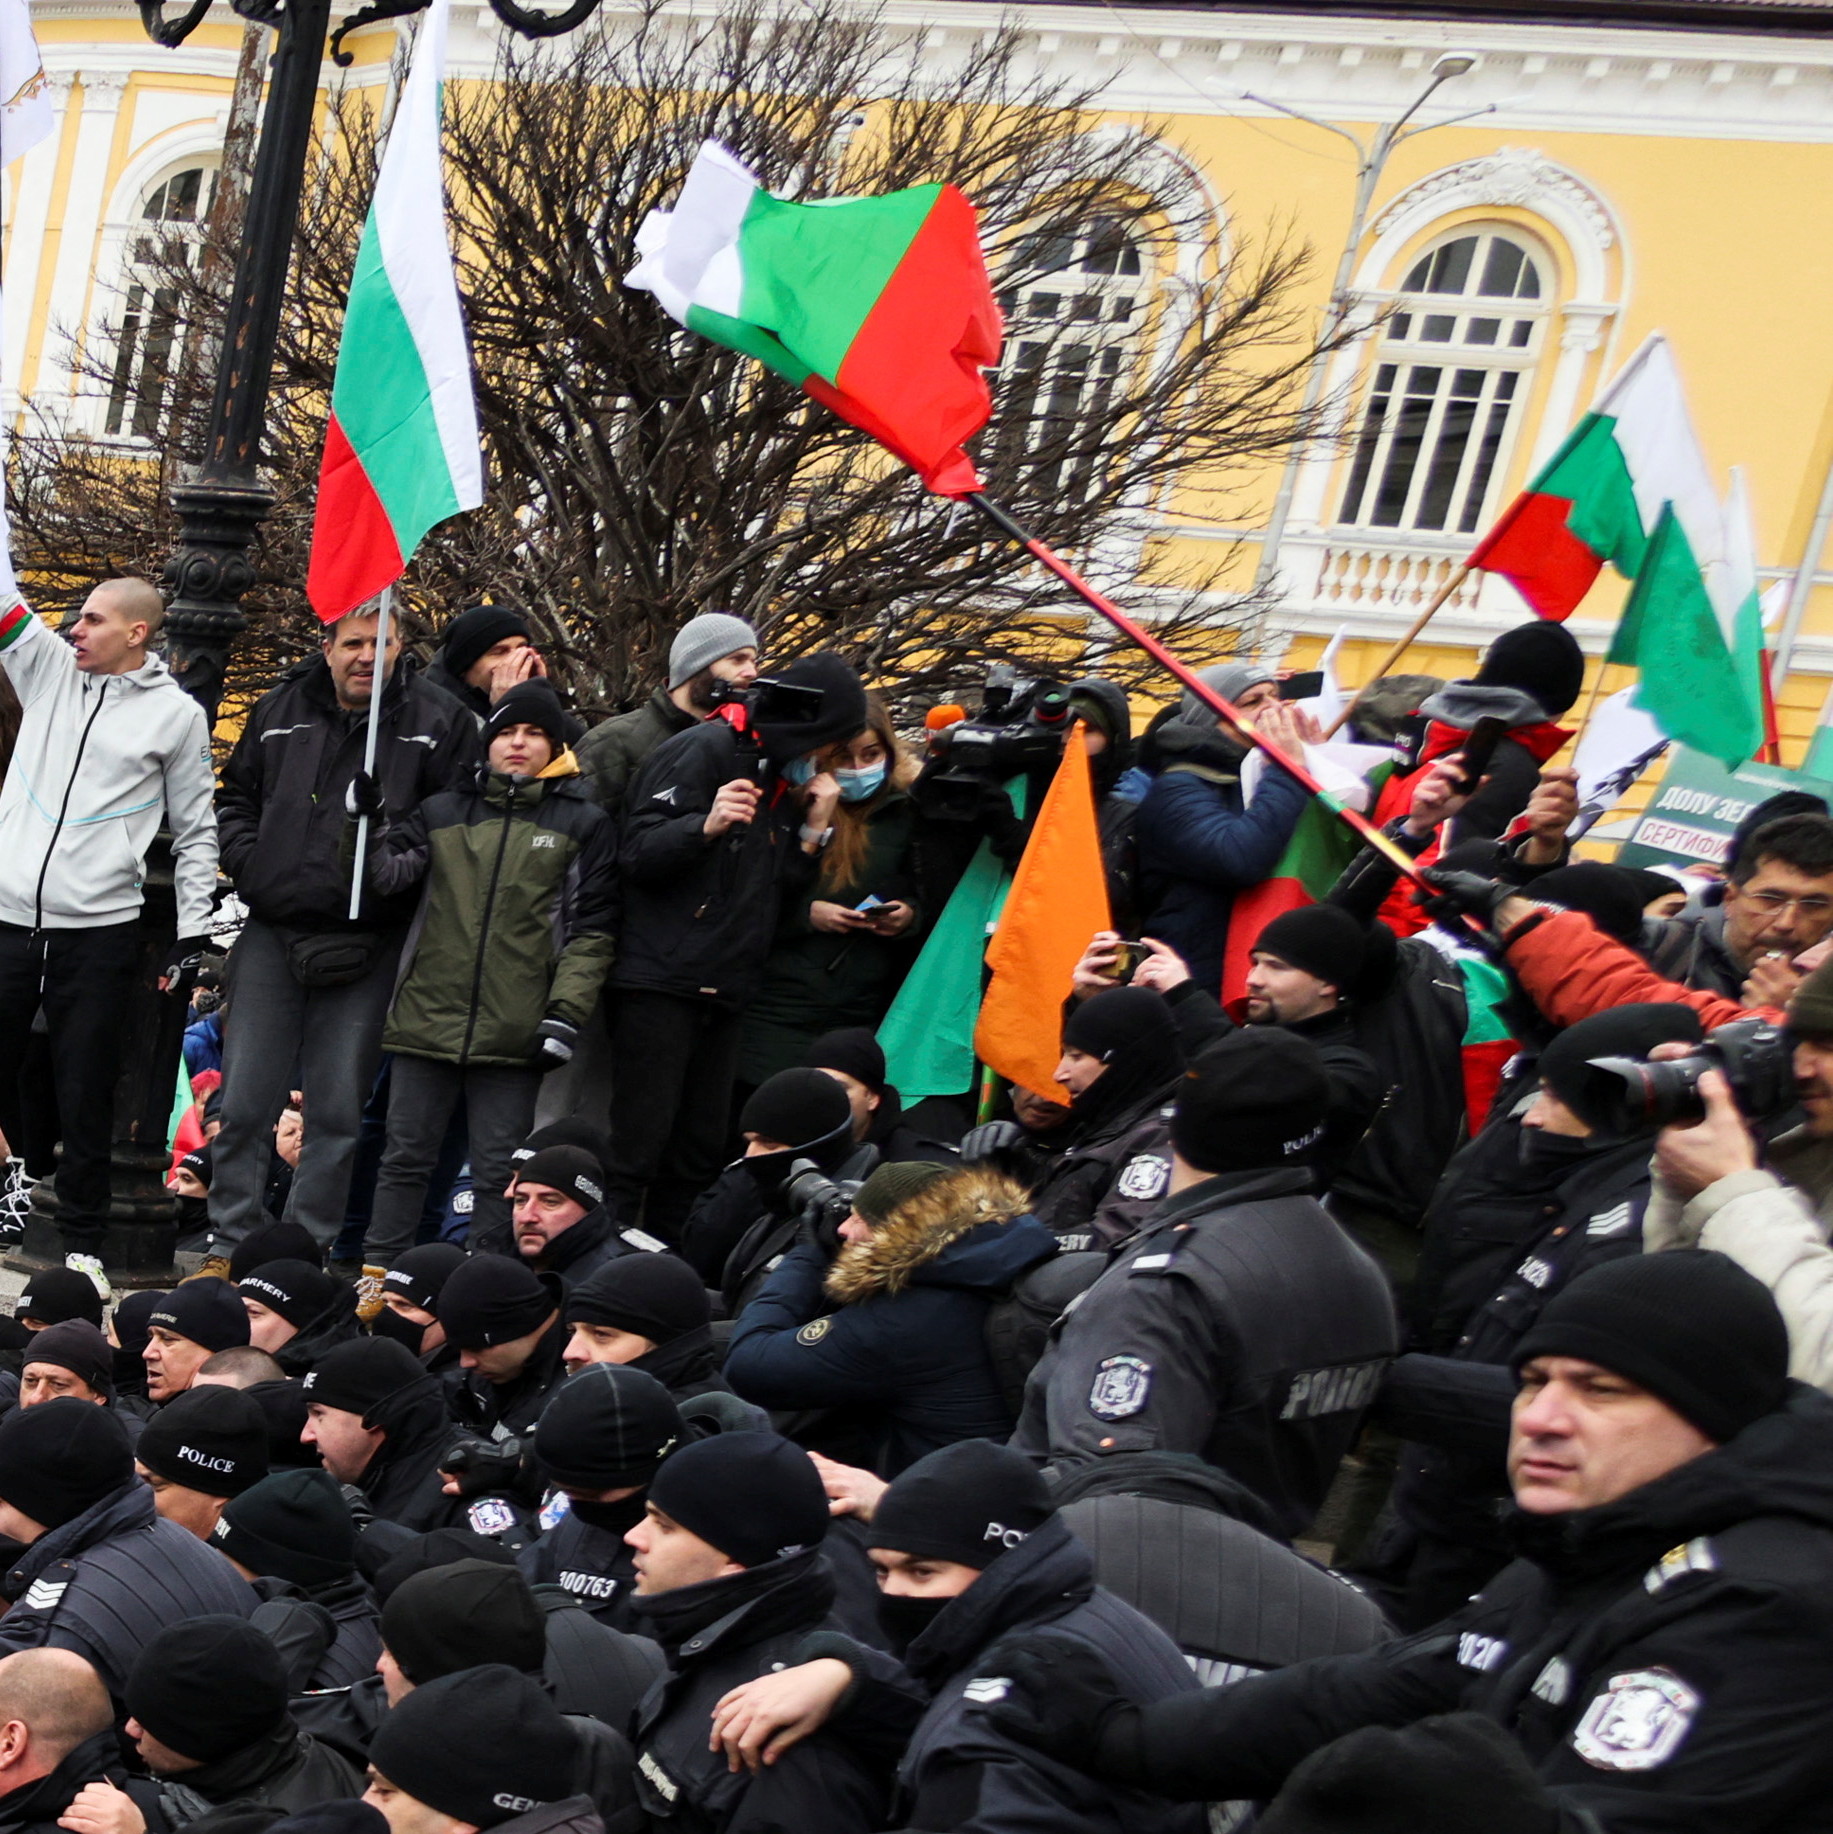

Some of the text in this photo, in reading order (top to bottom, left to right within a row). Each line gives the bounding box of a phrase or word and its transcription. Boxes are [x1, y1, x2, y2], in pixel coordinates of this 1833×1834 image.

[1656, 786, 1714, 818] ДОЛУ
[1639, 822, 1728, 861] СЕРТИФИ
[177, 1445, 236, 1474] POLICE
